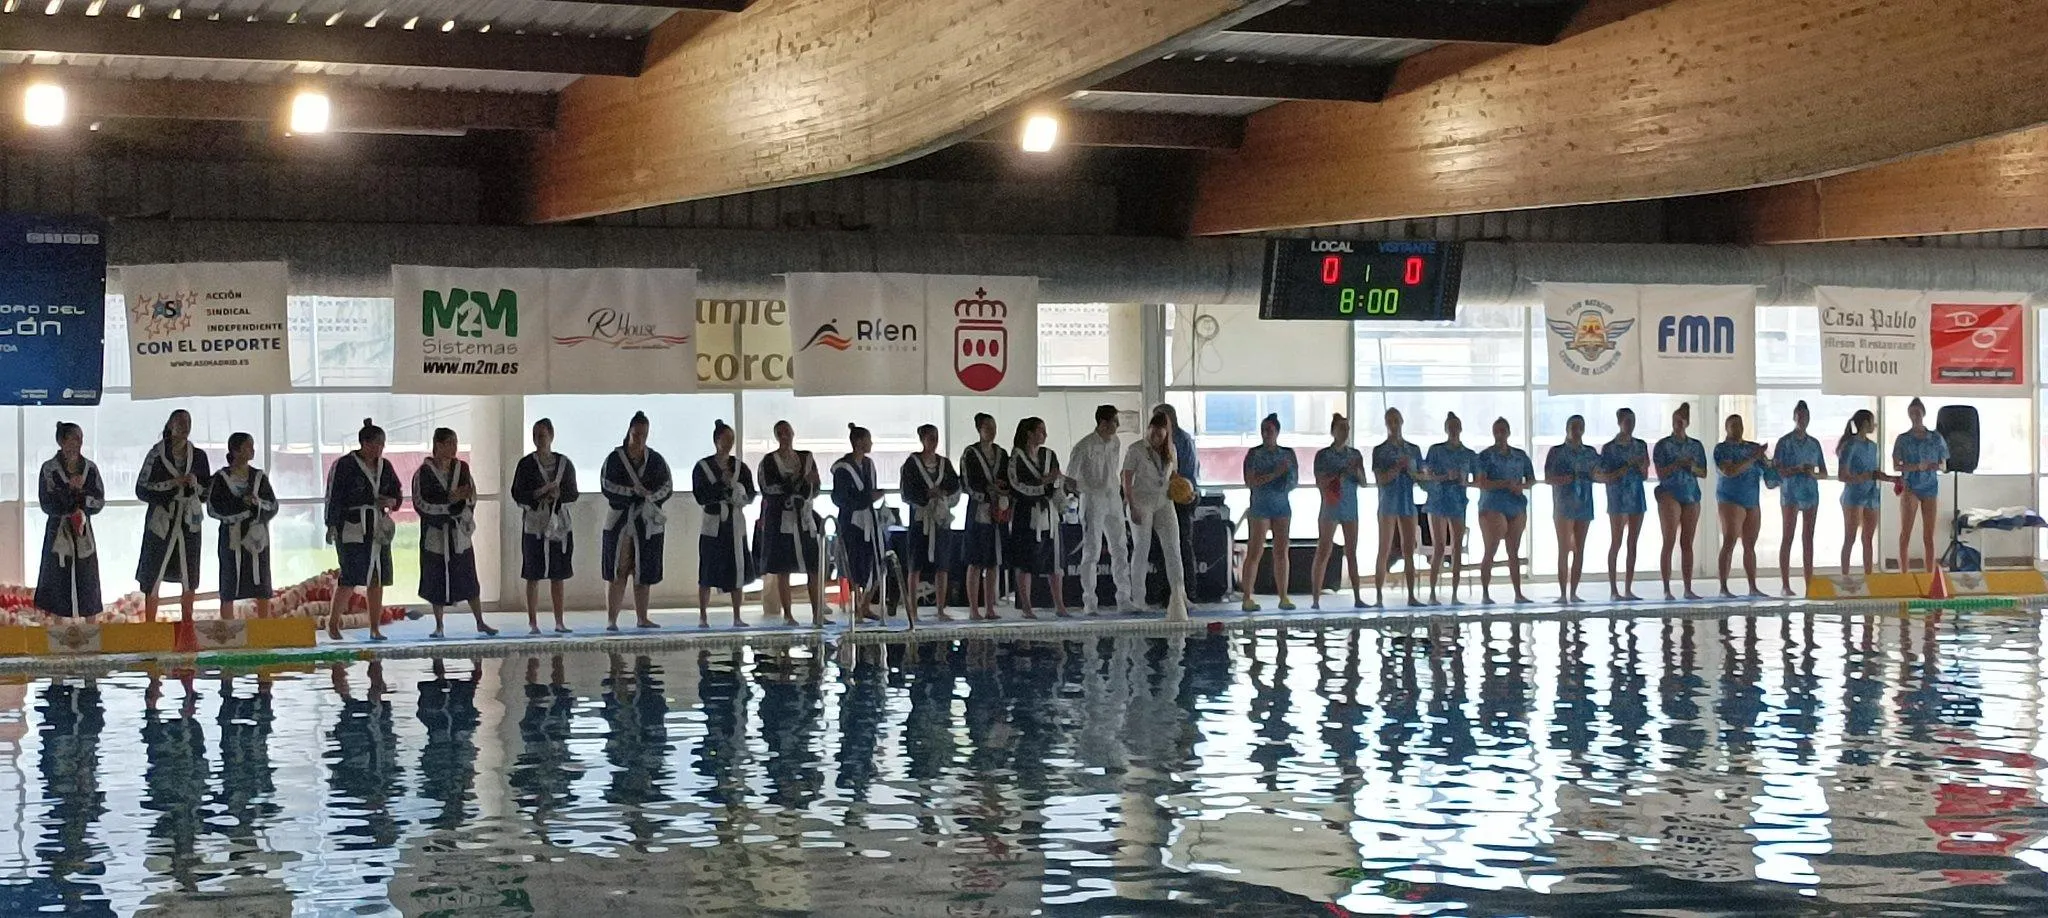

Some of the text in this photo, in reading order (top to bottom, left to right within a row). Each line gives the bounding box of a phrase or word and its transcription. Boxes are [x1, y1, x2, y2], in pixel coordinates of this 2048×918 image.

[1311, 240, 1354, 253] LOCAL
[1323, 257, 1340, 284] 0
[1404, 257, 1422, 284] 0
[206, 289, 242, 300] ACCIÓN
[1340, 288, 1399, 314] 8:00
[48, 305, 85, 315] DEL
[206, 307, 250, 316] SINDICAL
[423, 288, 518, 338] M2M
[1822, 306, 1917, 332] Casa Pablo
[207, 322, 284, 333] INDEPENDIENTE
[137, 338, 281, 355] CON EL DEPORTE
[423, 338, 518, 354] Sistemas
[1859, 338, 1916, 350] Restaurante
[423, 360, 519, 374] www.m2m.es
